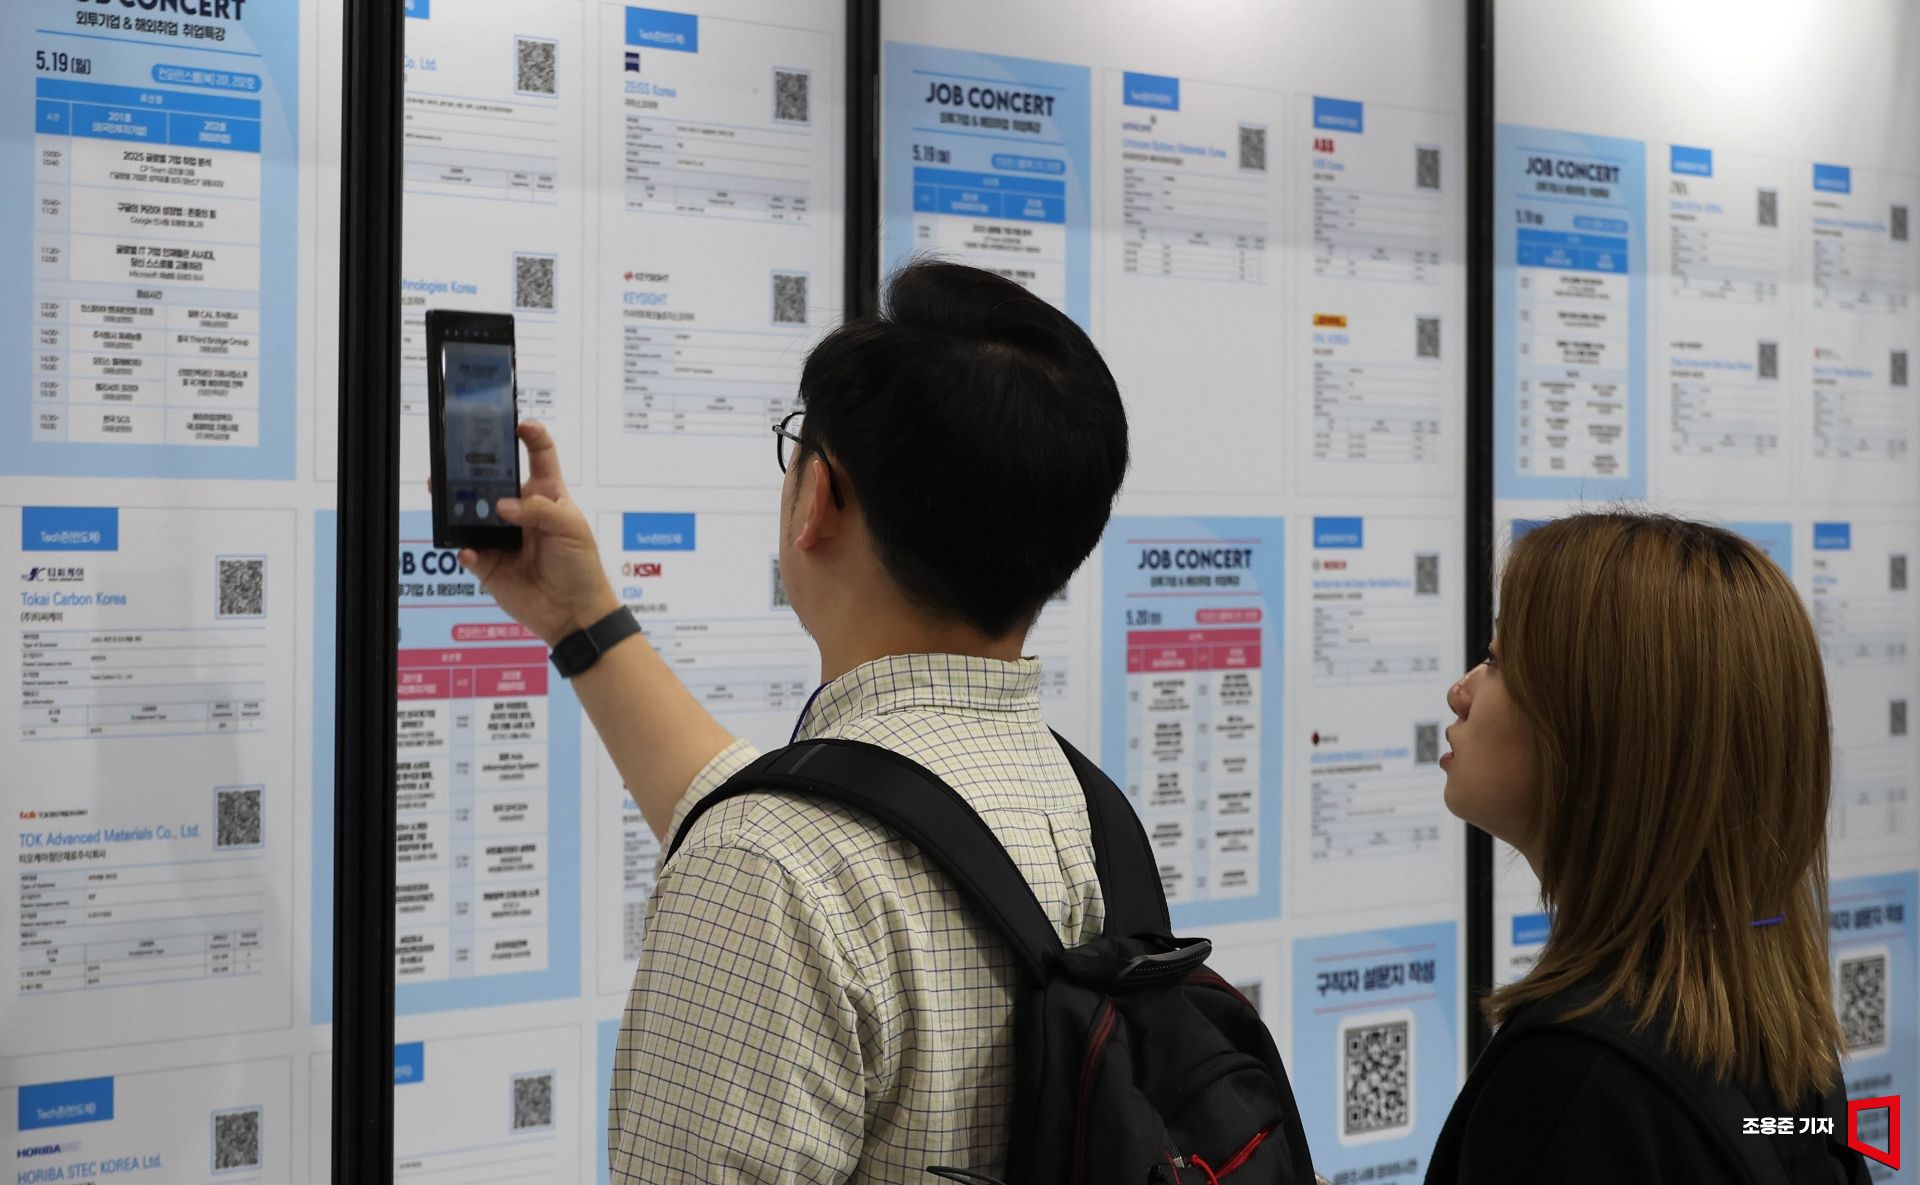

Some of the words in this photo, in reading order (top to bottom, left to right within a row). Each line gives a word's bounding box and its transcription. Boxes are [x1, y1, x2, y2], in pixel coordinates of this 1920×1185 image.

[120, 0, 246, 21] CERT
[76, 11, 120, 29] 외투기업
[123, 17, 132, 30] &
[135, 18, 178, 36] 해외취업
[182, 23, 226, 41] 취업특강
[36, 50, 68, 72] 5.19
[926, 82, 964, 106] JOB
[968, 87, 1055, 116] CONCERT
[123, 151, 144, 161] 2025
[1525, 157, 1552, 176] JOB
[1556, 160, 1620, 184] CONCERT
[130, 216, 152, 226] Google
[421, 551, 464, 575] CO
[633, 562, 662, 577] KSM
[1138, 549, 1171, 569] JOB
[1175, 549, 1253, 569] CONCERT
[21, 592, 50, 606] Tokai
[53, 591, 93, 606] Carbon
[96, 592, 127, 606] Korea
[19, 833, 43, 848] TOK
[46, 831, 101, 847] Advanced
[103, 827, 154, 843] Materials
[180, 824, 201, 838] Ltd.
[1316, 969, 1360, 997] 구직자
[1363, 964, 1405, 992] 설문지
[1408, 959, 1436, 984] 작성
[17, 1143, 61, 1158] HORIBA
[17, 1166, 65, 1185] HORIBA
[67, 1162, 97, 1180] STEC
[100, 1156, 140, 1174] KOREA
